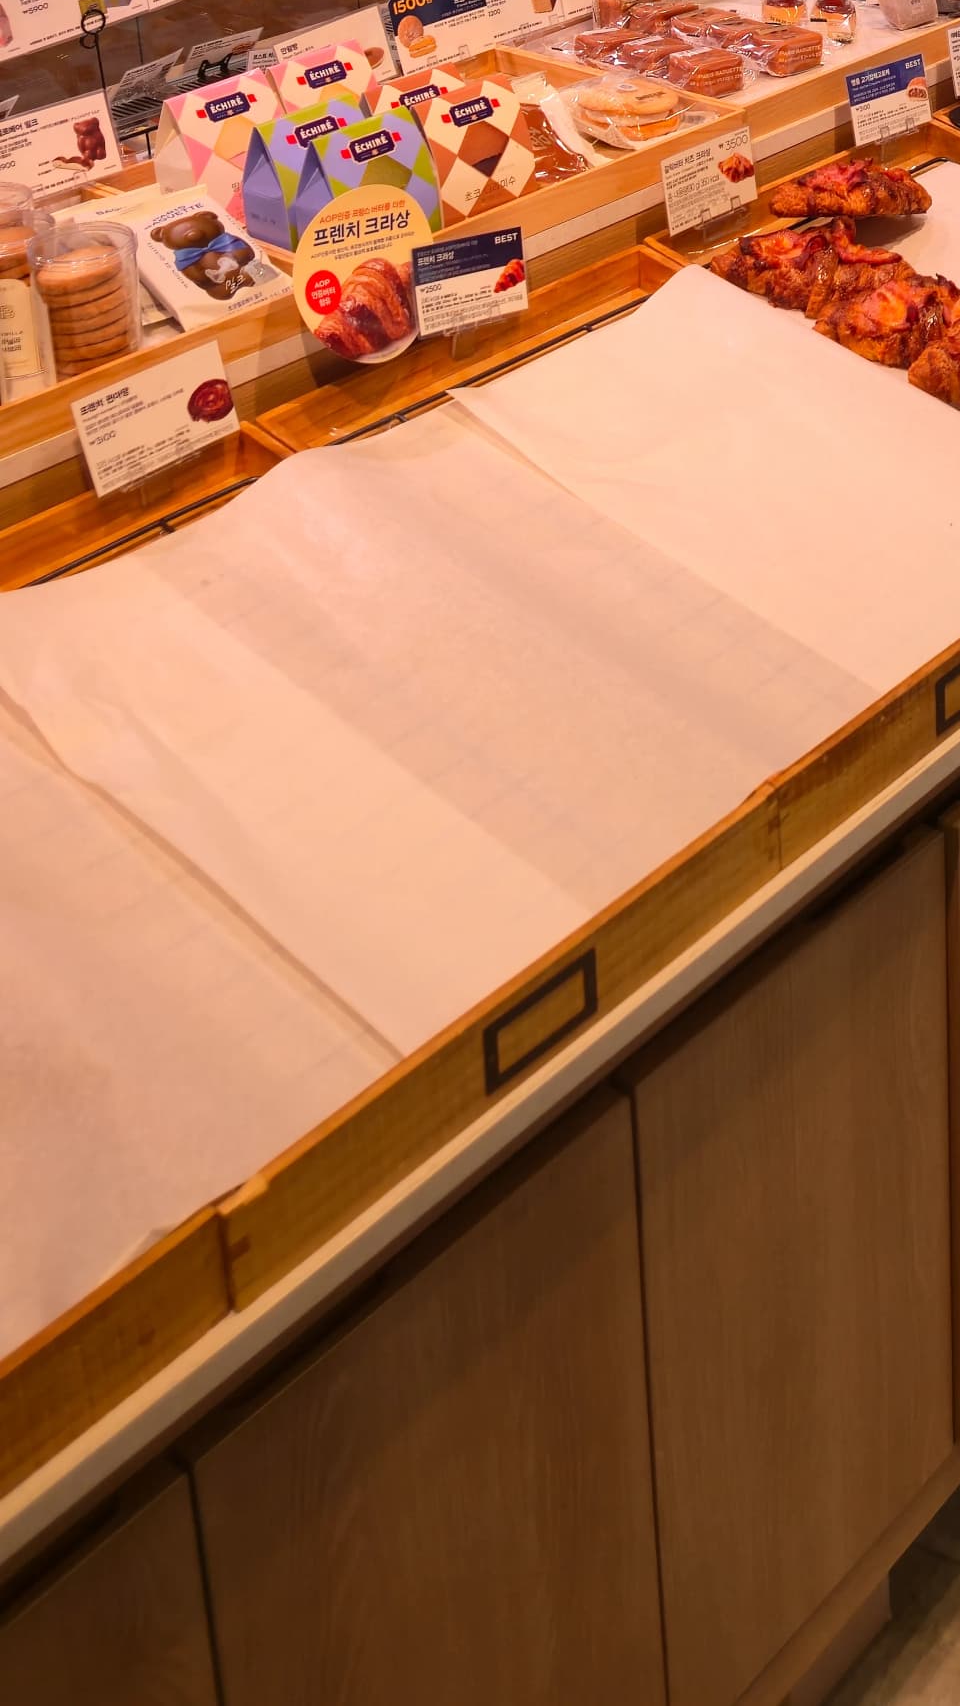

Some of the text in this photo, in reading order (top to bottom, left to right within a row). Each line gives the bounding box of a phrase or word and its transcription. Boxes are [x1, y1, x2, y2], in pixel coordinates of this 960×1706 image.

[905, 59, 921, 69] BEST
[309, 65, 342, 81] ÉCHIRÉ
[209, 96, 245, 114] ÉCHIRÉ
[403, 88, 437, 105] ÉCHIRÉ
[453, 101, 489, 119] ÉCHIRÉ
[299, 121, 334, 139] ÉCHIRÉ
[354, 135, 389, 153] ÉCHIRÉ
[725, 134, 749, 151] 3500
[319, 208, 351, 224] AOP인증
[313, 220, 361, 246] 프렌치
[365, 209, 411, 236] 크라상
[495, 232, 519, 245] BEST
[314, 278, 331, 290] AOP
